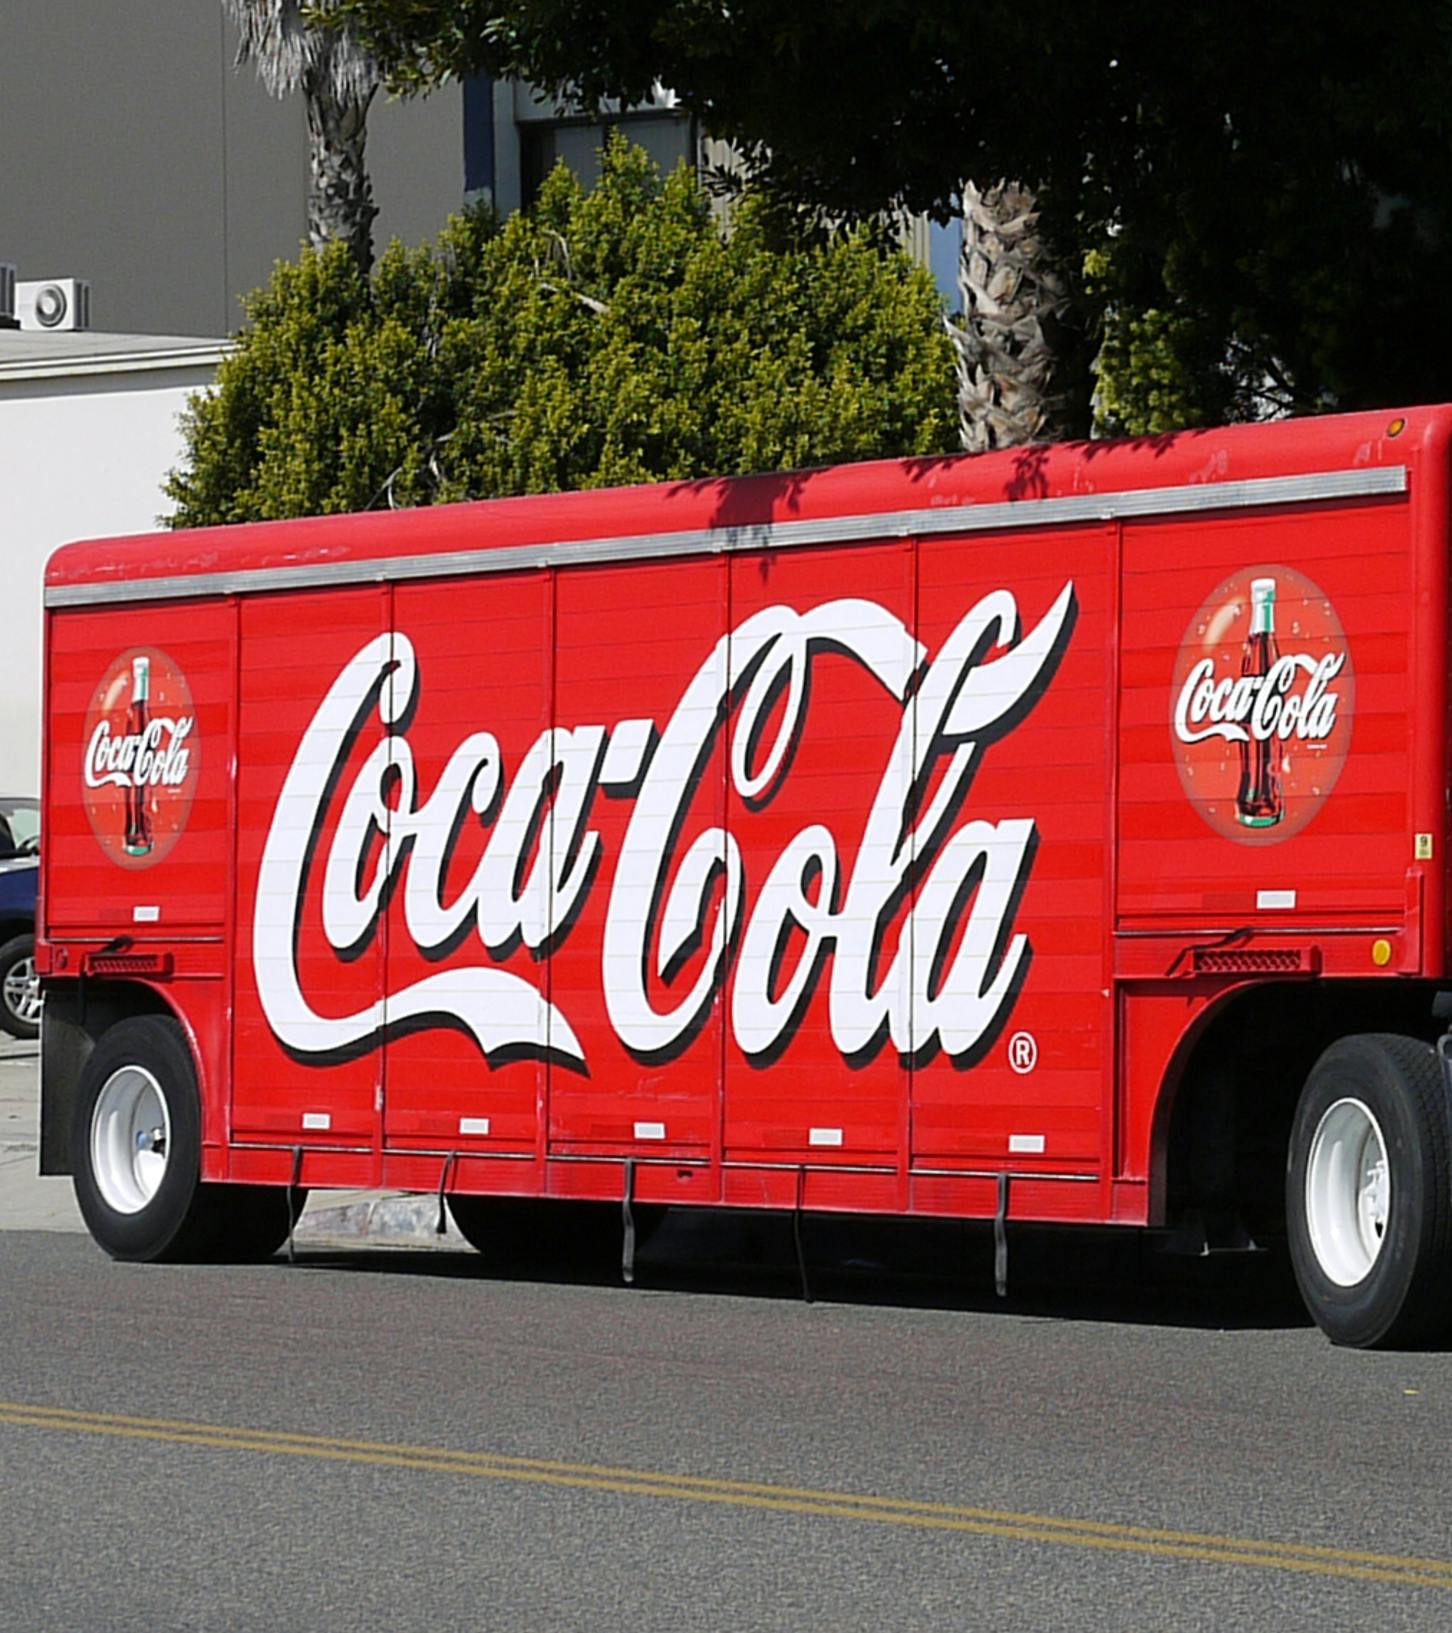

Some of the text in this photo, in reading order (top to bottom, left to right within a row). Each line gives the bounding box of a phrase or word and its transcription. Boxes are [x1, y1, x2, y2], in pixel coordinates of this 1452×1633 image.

[1175, 651, 1345, 744] Coca-Cola
[85, 716, 193, 787] Coca-Cola
[253, 580, 1075, 1064] Coca-Cola
